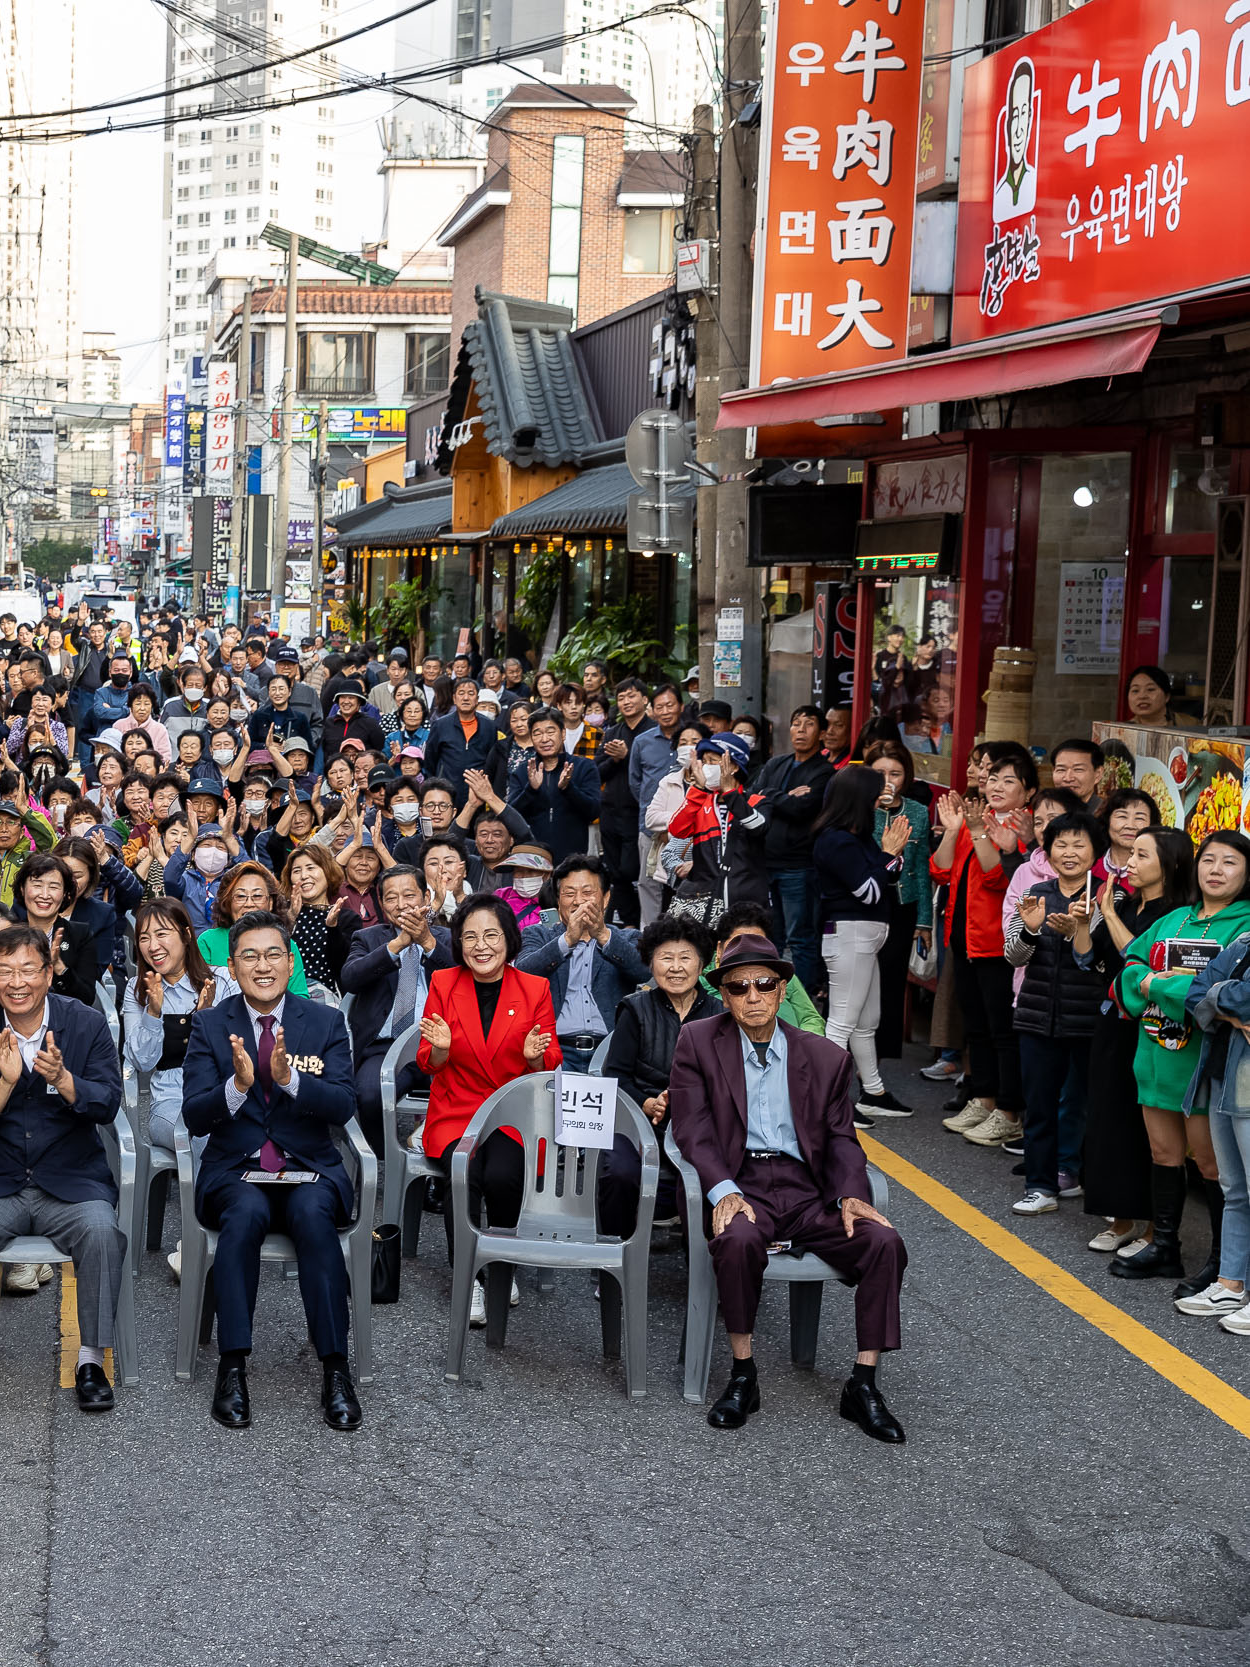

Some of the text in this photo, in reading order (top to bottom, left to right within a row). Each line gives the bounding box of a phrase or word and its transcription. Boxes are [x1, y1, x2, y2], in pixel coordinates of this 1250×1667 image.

[771, 0, 826, 386] 우육면대
[1061, 155, 1188, 262] 우육면대왕
[1092, 568, 1108, 580] 10
[588, 1121, 604, 1131] 의장
